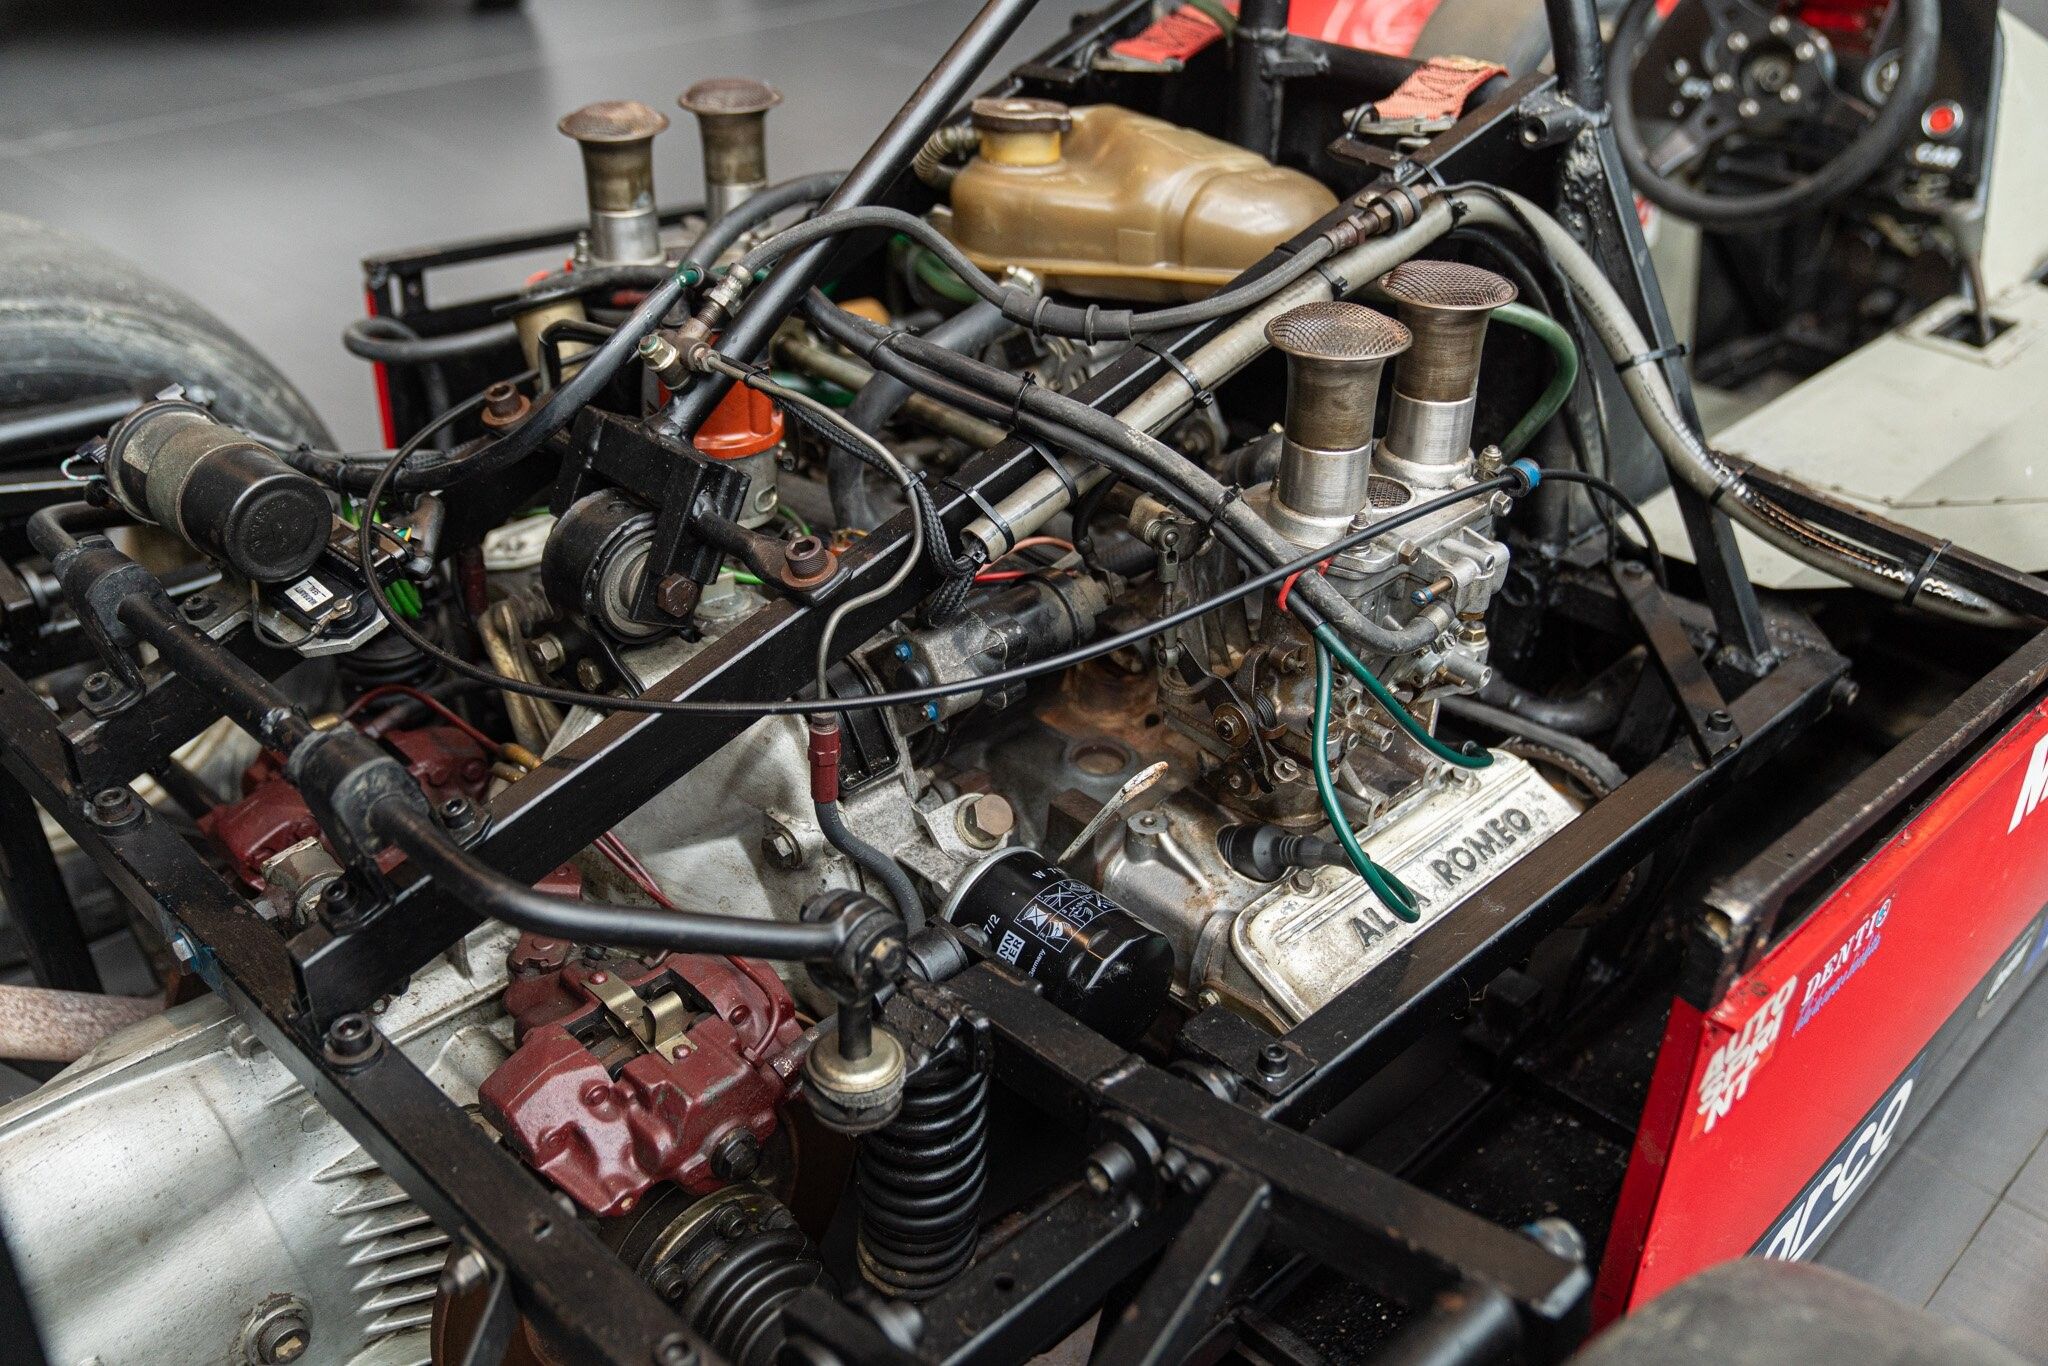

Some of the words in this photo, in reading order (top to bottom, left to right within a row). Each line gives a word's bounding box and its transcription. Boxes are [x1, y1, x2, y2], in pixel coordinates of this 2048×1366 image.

[1352, 884, 1431, 948] ALA
[1429, 808, 1531, 887] ROMEO
[1698, 975, 1797, 1093] AUTO
